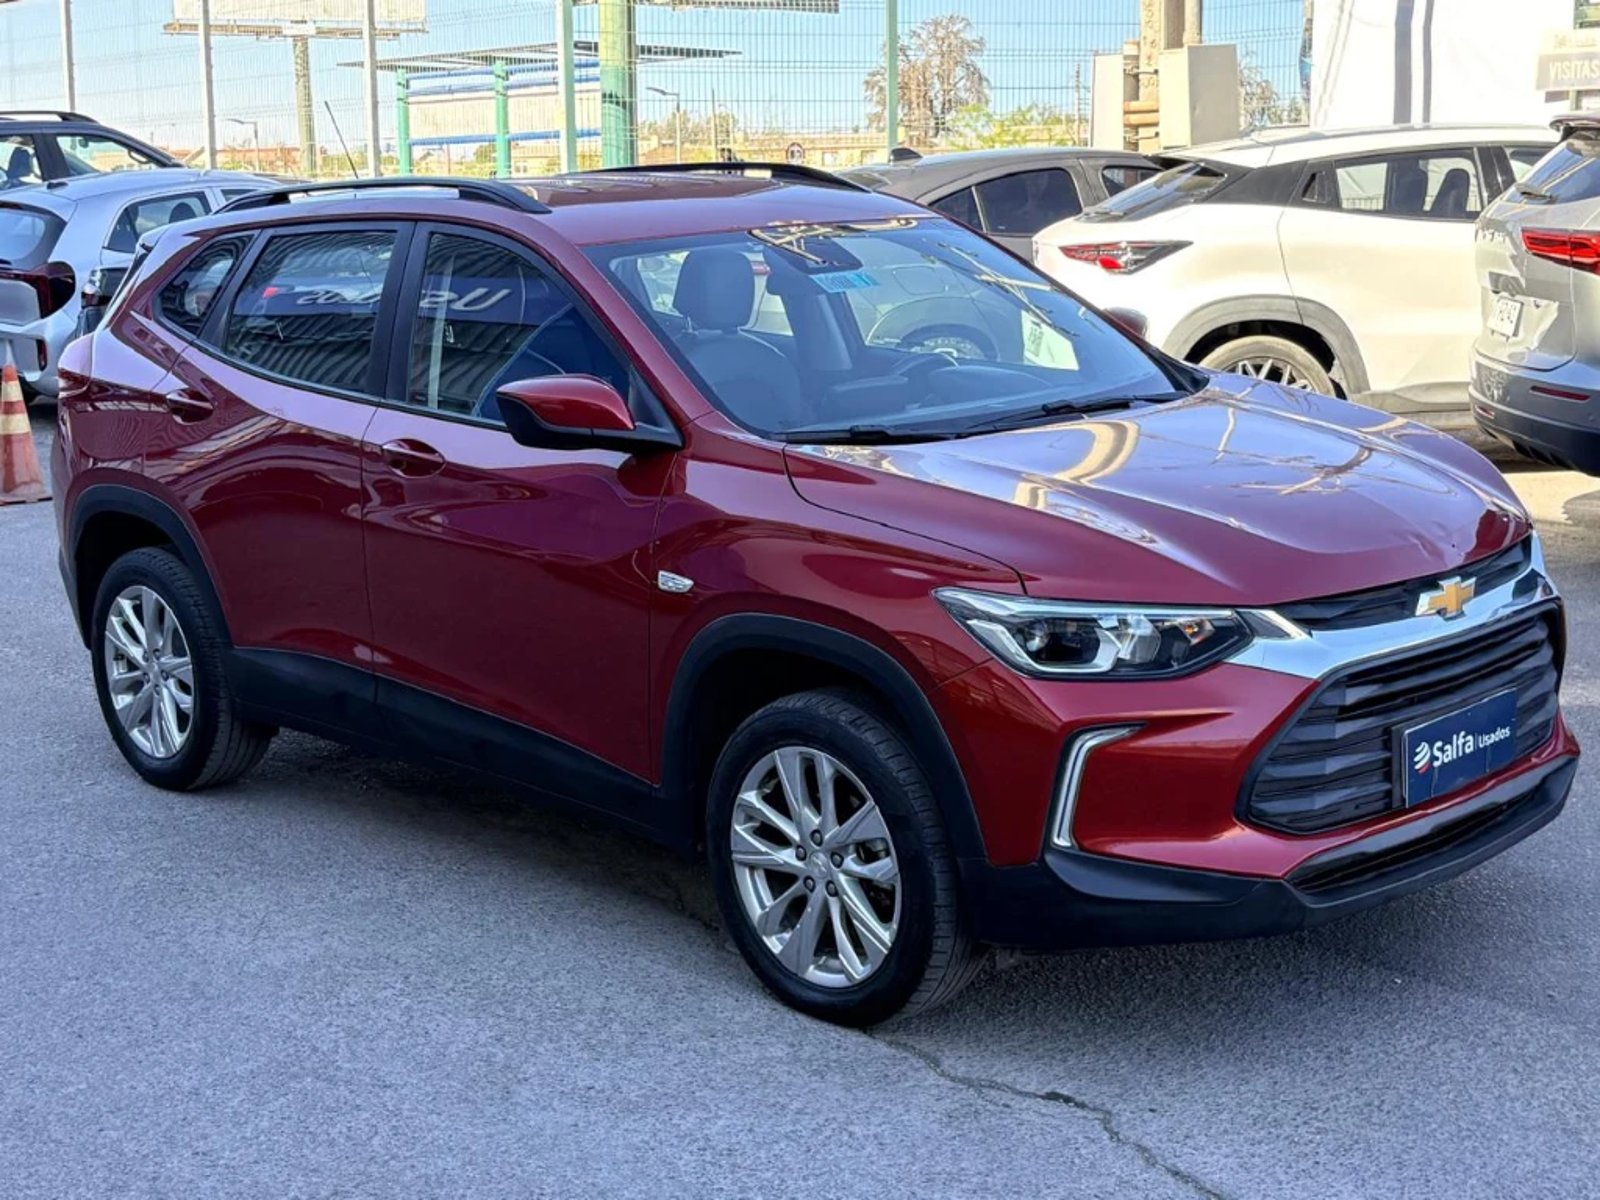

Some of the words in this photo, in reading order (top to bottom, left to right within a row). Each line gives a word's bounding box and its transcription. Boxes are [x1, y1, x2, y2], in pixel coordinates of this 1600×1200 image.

[1549, 59, 1600, 80] VISITAS
[1432, 730, 1474, 768] Salfa
[1478, 726, 1511, 748] Usados
